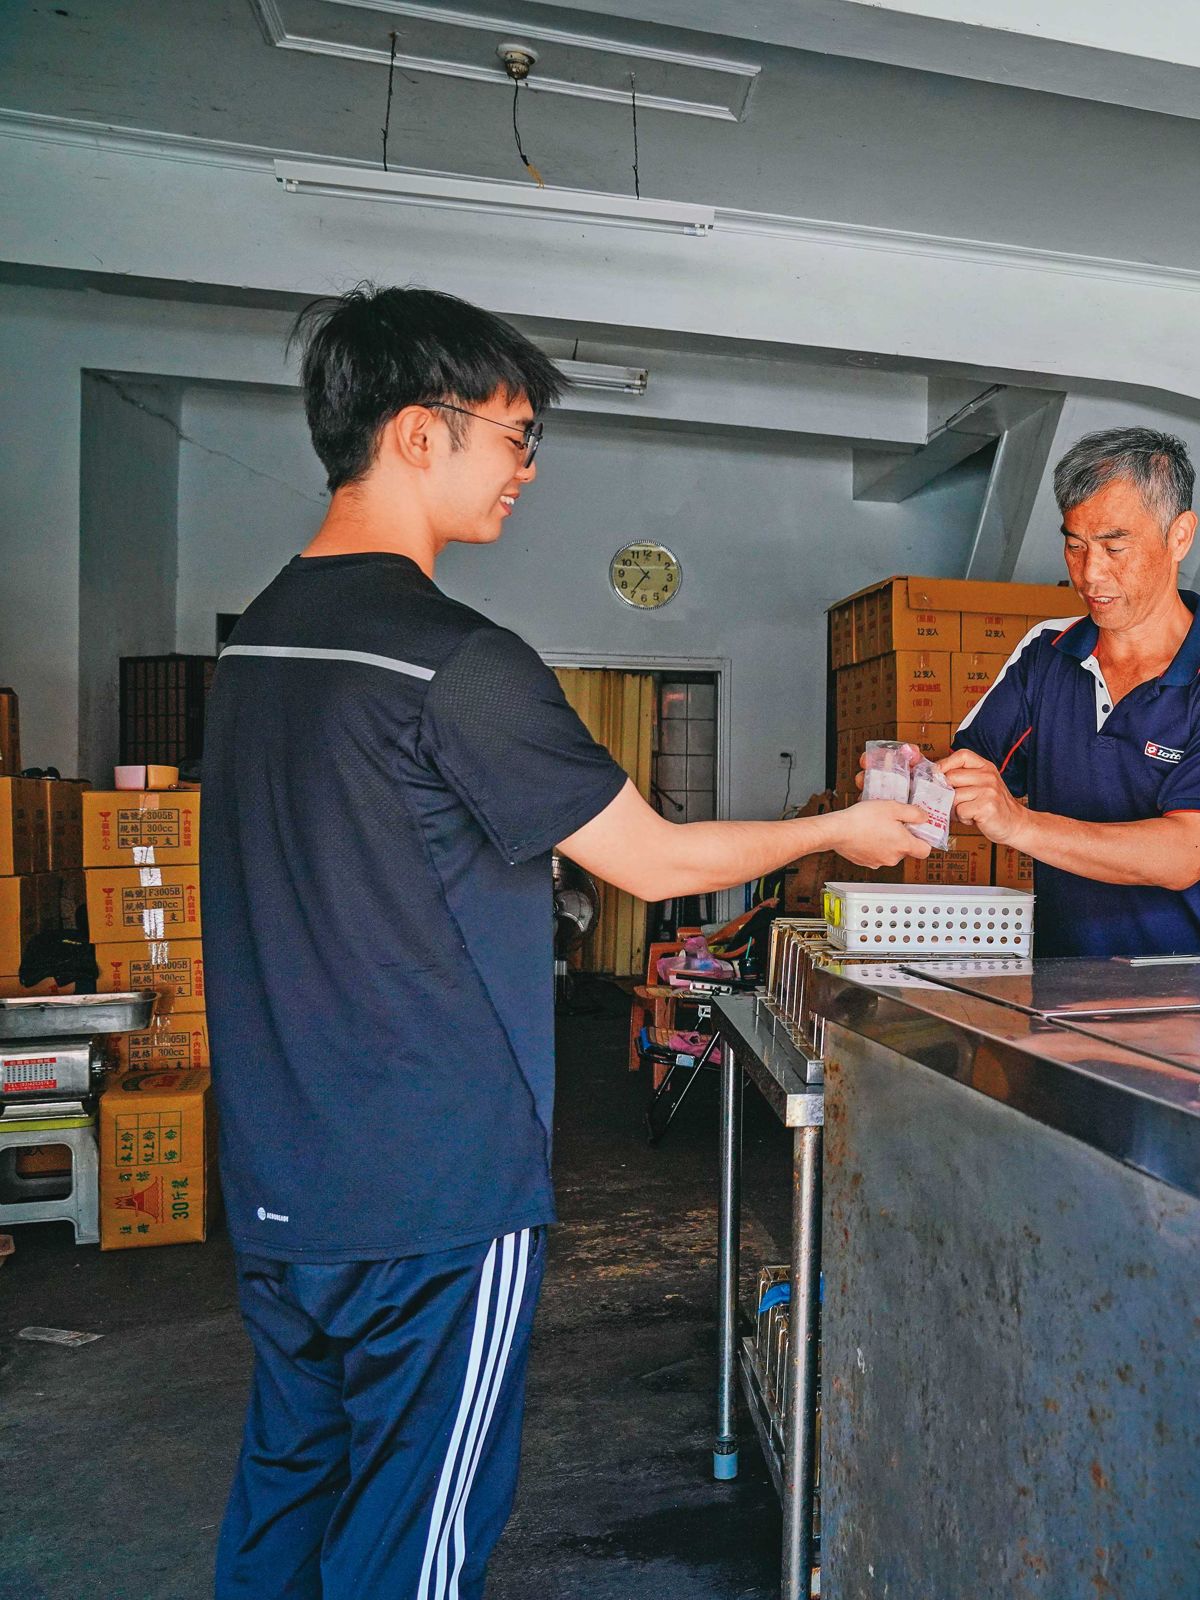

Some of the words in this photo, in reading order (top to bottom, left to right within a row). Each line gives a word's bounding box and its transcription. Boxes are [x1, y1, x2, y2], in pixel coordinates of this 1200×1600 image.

[631, 551, 640, 559] 11
[643, 550, 652, 558] 12
[622, 559, 632, 567] 10
[664, 562, 671, 570] 2
[618, 569, 625, 577] 9
[667, 573, 673, 582] 3
[621, 581, 628, 589] 8
[631, 590, 636, 598] 7
[641, 594, 647, 602] 6
[653, 592, 659, 600] 5
[147, 824, 173, 832] 300cc
[149, 888, 180, 896] F3005B
[152, 901, 178, 909] 300cc
[158, 1047, 184, 1056] 300cc
